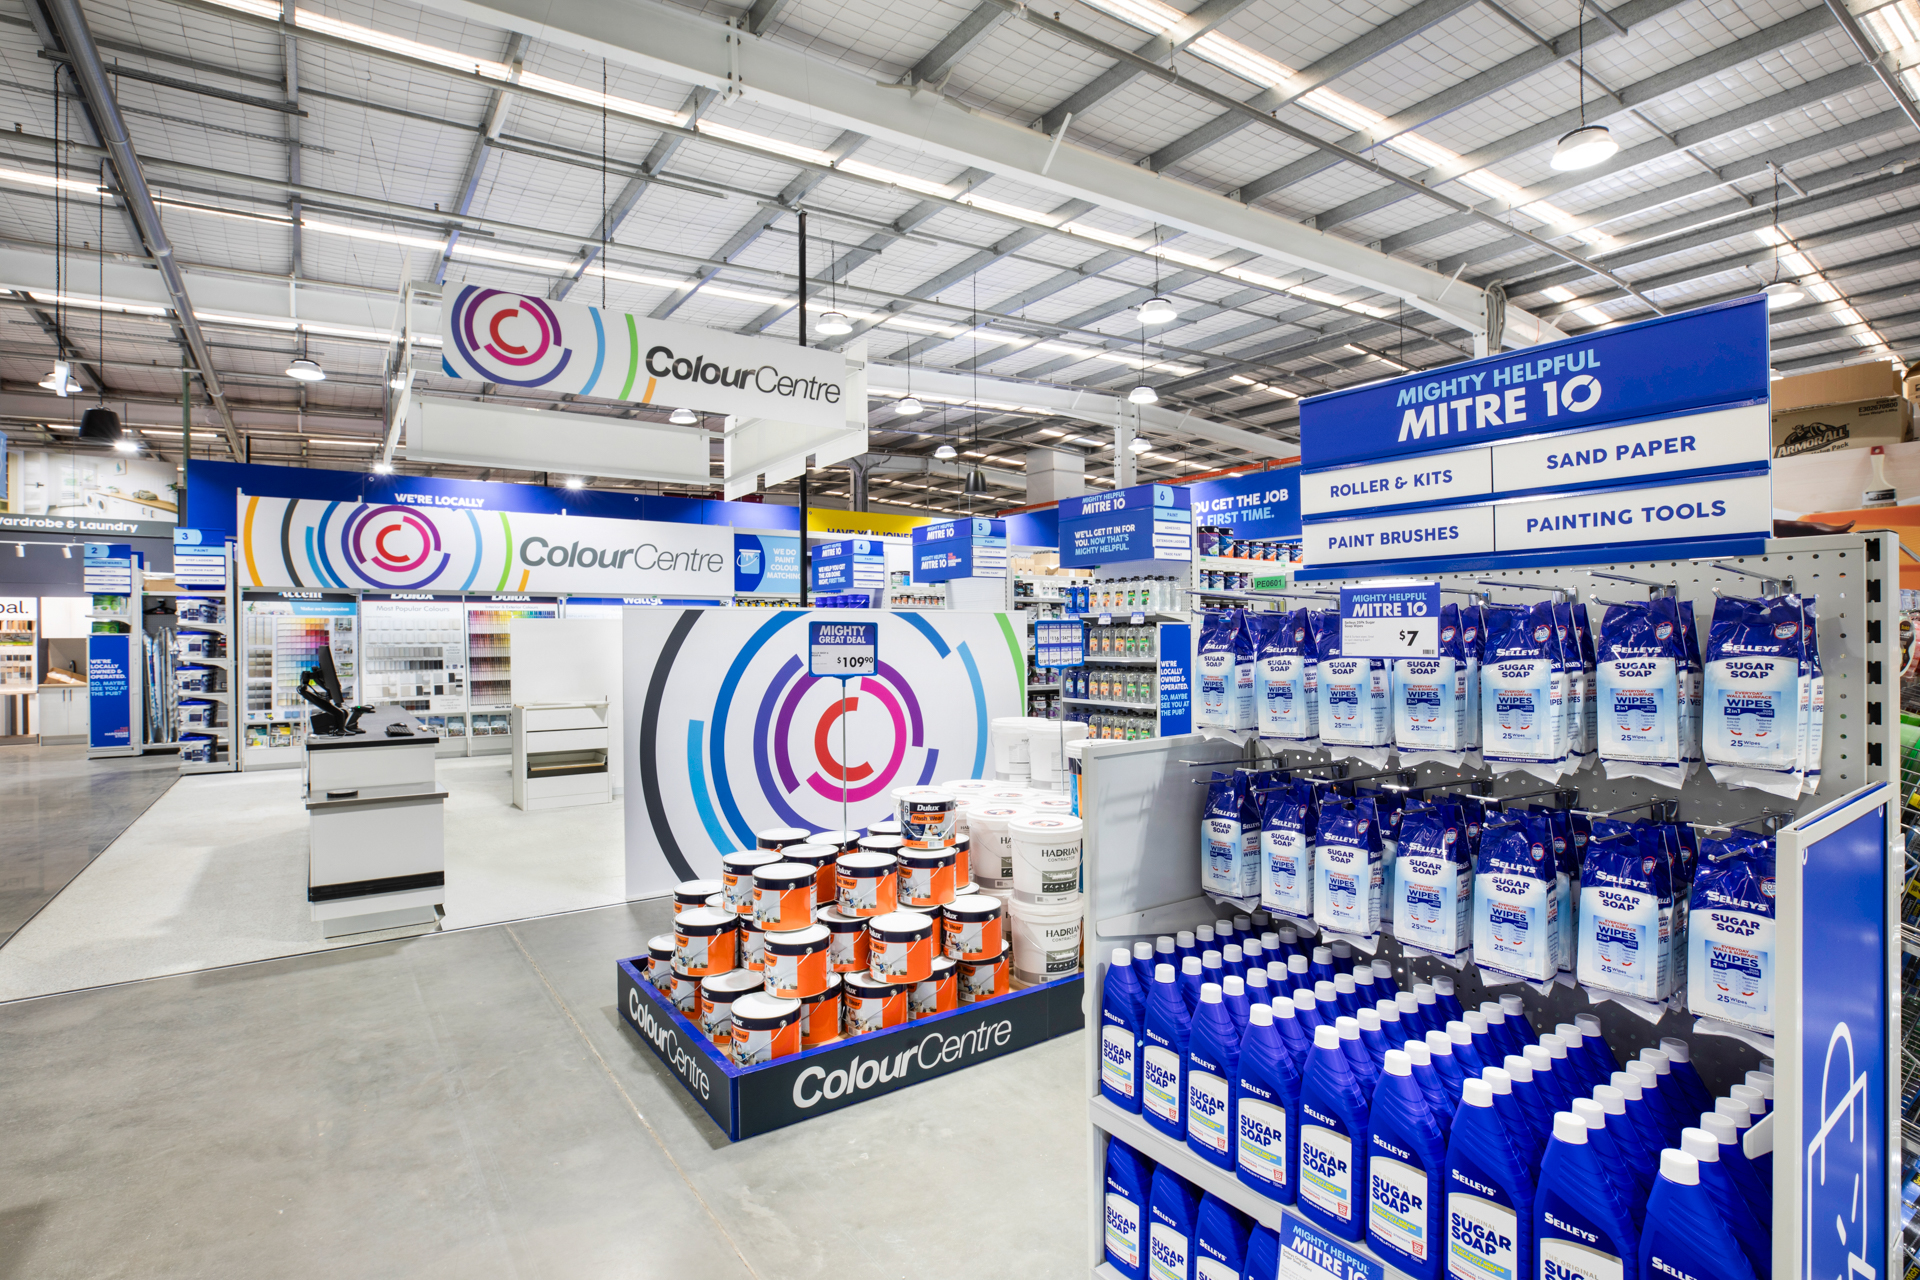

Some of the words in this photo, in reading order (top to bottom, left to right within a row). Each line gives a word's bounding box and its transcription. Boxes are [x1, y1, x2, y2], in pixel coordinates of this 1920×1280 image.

[645, 345, 841, 404] ColourCentre
[1397, 372, 1488, 407] MIGHTY
[1493, 348, 1601, 387] HELPFUL
[1397, 387, 1526, 442] MITRE
[1543, 374, 1602, 417] 10
[1546, 448, 1607, 471] SAND
[1616, 435, 1696, 460] PAPER
[1831, 441, 1849, 452] Pack
[1330, 478, 1390, 499] ROLLER
[1394, 476, 1408, 490] &
[1413, 469, 1453, 487] KITS
[394, 493, 433, 504] WE'RE
[435, 496, 484, 508] LOCALLY
[1082, 495, 1102, 504] MIGHTY
[1104, 491, 1126, 501] HELPFUL
[1160, 490, 1165, 501] 6
[1212, 497, 1234, 511] GET
[1236, 492, 1260, 507] THE
[1263, 488, 1288, 504] JOB
[1082, 500, 1111, 515] MITRE
[1113, 498, 1126, 510] 10
[1208, 512, 1238, 526] FIRST
[1241, 507, 1274, 522] TIME.
[1527, 508, 1633, 534] PAINTING
[1640, 500, 1726, 523] TOOLS
[66, 520, 78, 529] &
[80, 520, 138, 533] Laundry
[926, 529, 946, 540] MITRE
[946, 528, 954, 538] 10
[978, 523, 983, 531] 5
[1074, 530, 1092, 539] WE'LL
[1094, 528, 1106, 537] GET
[1114, 526, 1121, 534] IN
[1122, 524, 1136, 532] FOR
[182, 532, 188, 540] 3
[1074, 538, 1090, 548] YOU.
[1090, 536, 1106, 545] NOW
[1106, 534, 1130, 543] THAT'S
[1328, 533, 1375, 550] PAINT
[1380, 525, 1459, 544] BRUSHES
[519, 535, 724, 574] ColourCentre
[1074, 546, 1098, 556] MIGHTY
[1100, 543, 1130, 553] HELPFUL.
[770, 564, 798, 572] COLOUR
[775, 556, 794, 564] PAINT
[920, 560, 938, 570] MITRE
[940, 558, 946, 568] 10
[1352, 594, 1387, 603] MIGHTY
[1389, 592, 1427, 601] HELPFUL
[1352, 602, 1402, 617] MITRE
[1407, 601, 1427, 616] 10
[819, 625, 866, 636] MIGHTY
[1399, 629, 1419, 646] $7
[1721, 643, 1780, 653] SELLEYS
[1726, 662, 1774, 671] SUGAR
[1160, 683, 1188, 691] OPERATED.
[1726, 699, 1772, 708] WIPES
[1042, 846, 1079, 857] HADRIAN
[1711, 913, 1760, 930] SUGAR
[1716, 922, 1754, 936] SOAP
[628, 987, 710, 1101] ColourCentre
[793, 1019, 1012, 1109] ColourCentre
[1241, 1078, 1272, 1098] SELLEYS
[1240, 1114, 1282, 1142] SUGAR
[1240, 1125, 1271, 1147] SOAP
[1452, 1168, 1496, 1197] SELLEYS
[1465, 1212, 1496, 1231] ORIGINAL
[1451, 1225, 1497, 1256] SOAP
[1452, 1212, 1512, 1252] SUGAR
[1292, 1236, 1343, 1277] MITRE
[1293, 1225, 1329, 1250] MIGHTY
[1330, 1246, 1369, 1275] HELPFUL
